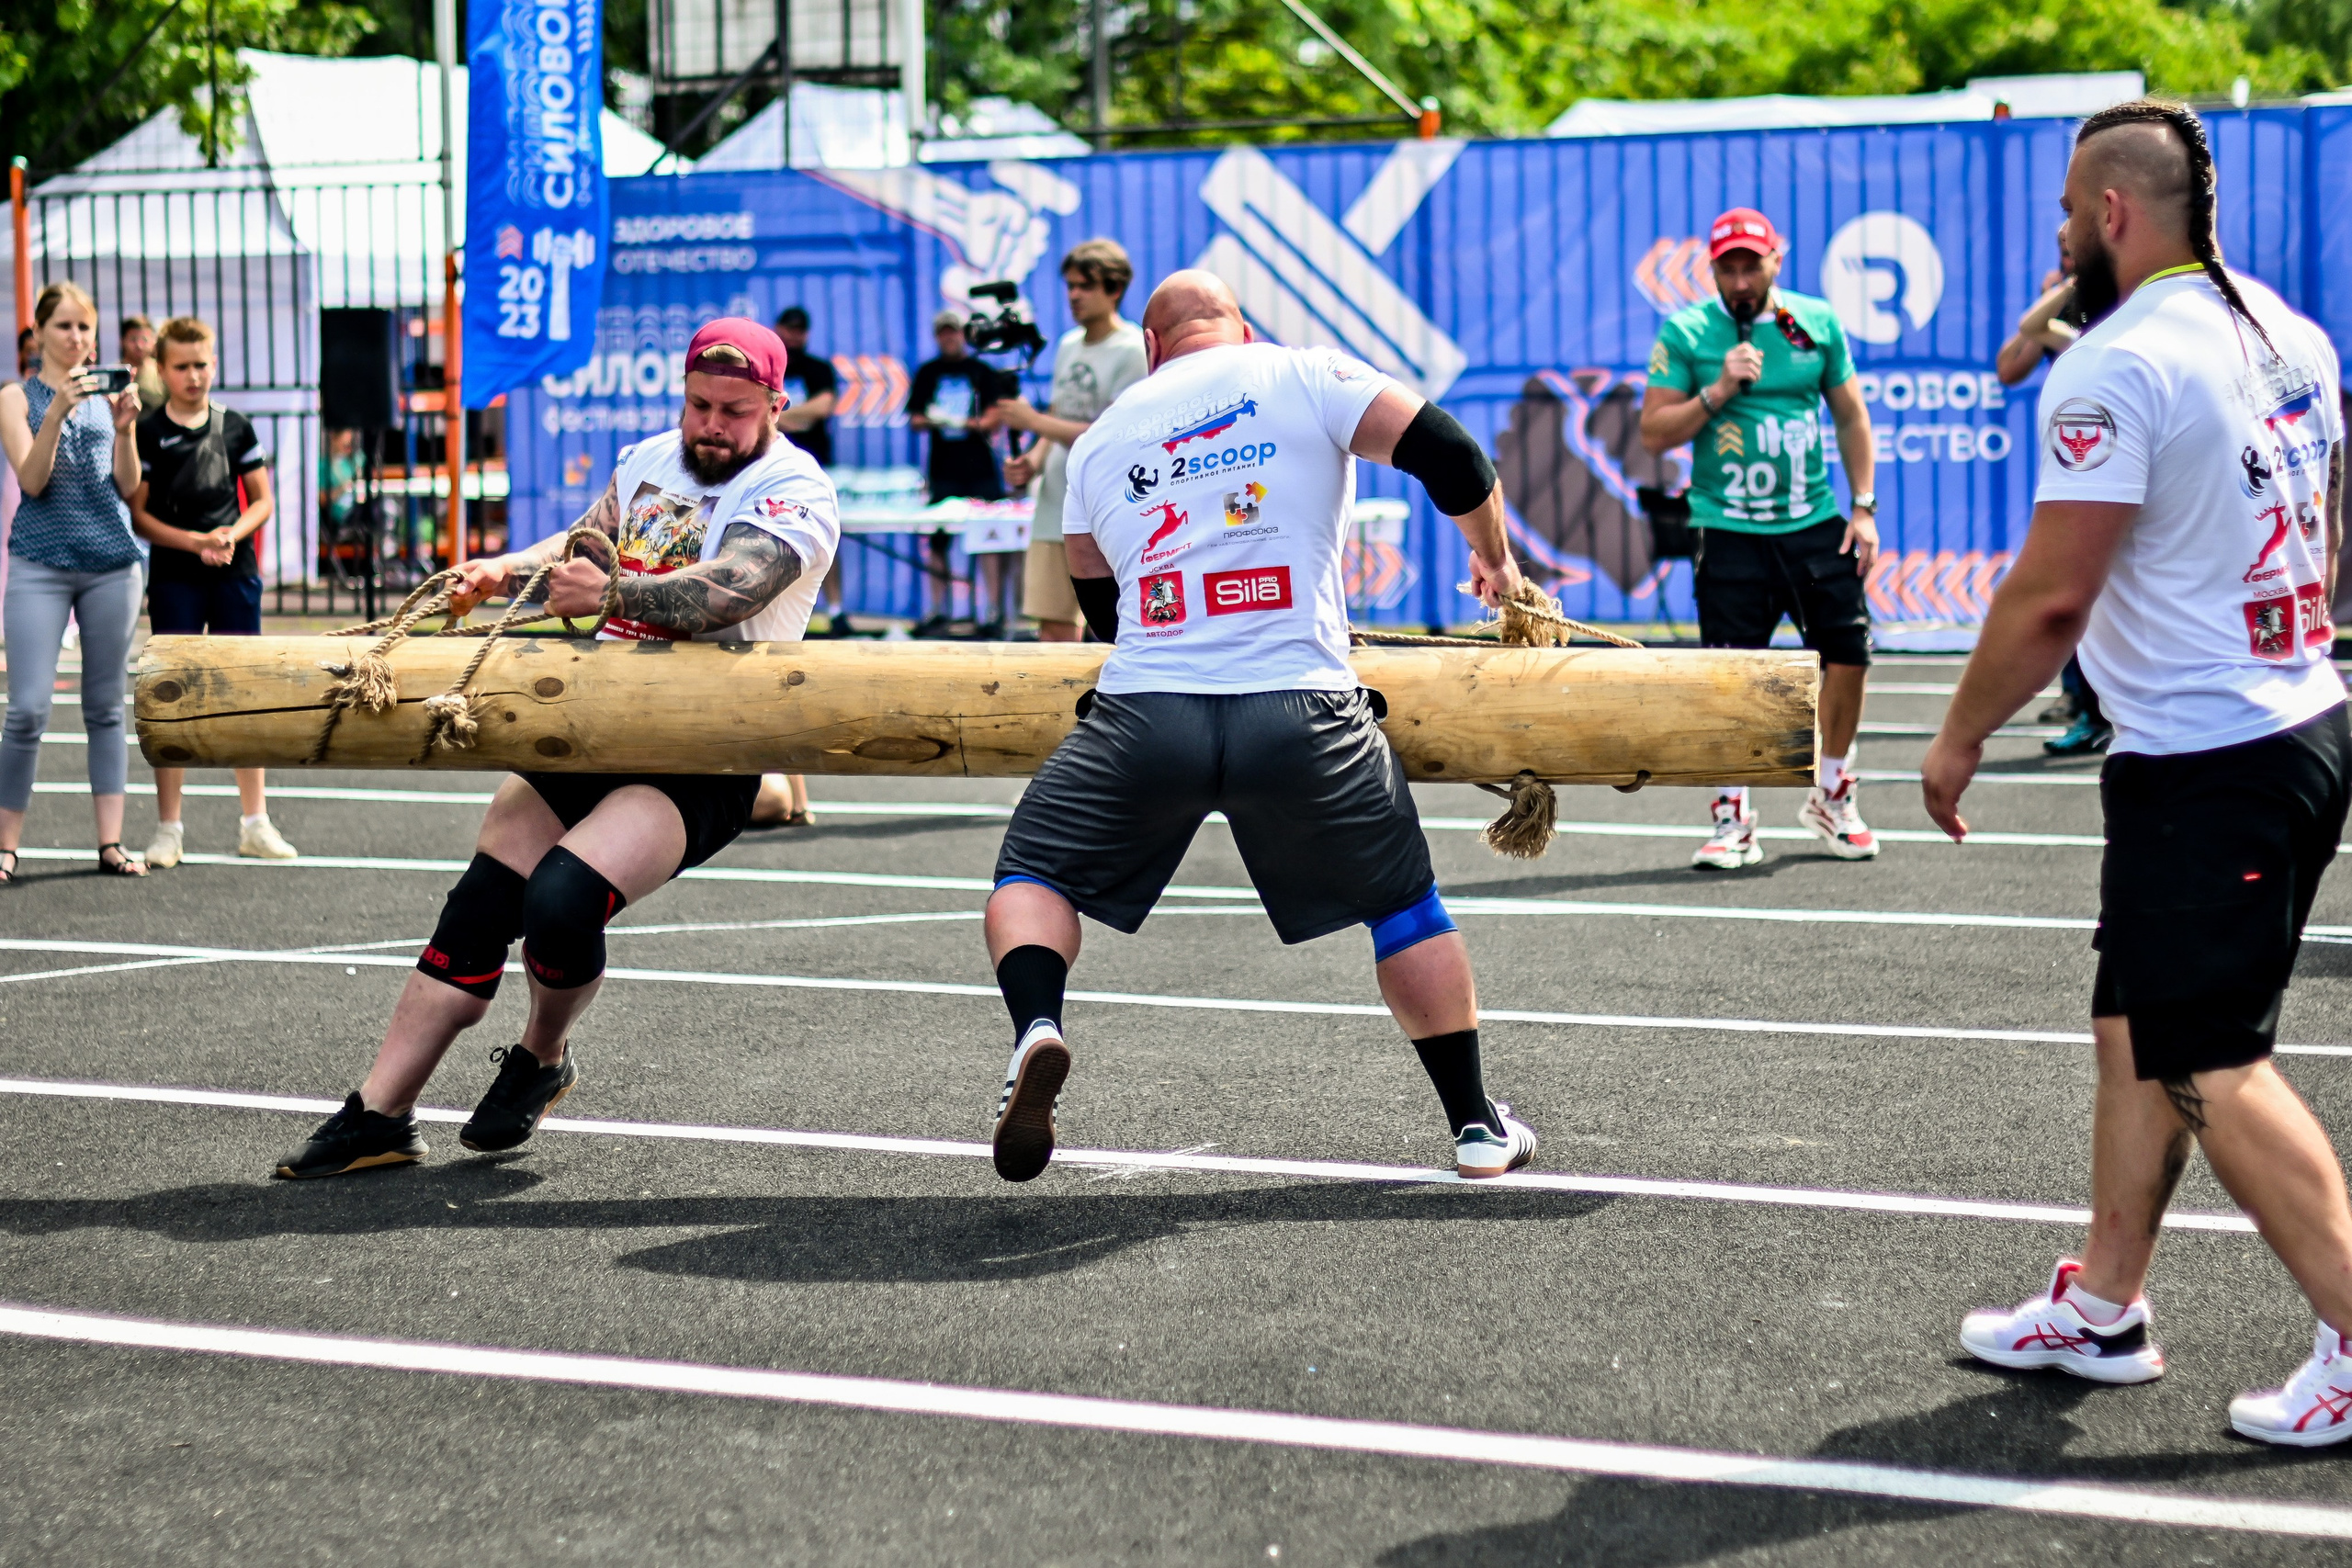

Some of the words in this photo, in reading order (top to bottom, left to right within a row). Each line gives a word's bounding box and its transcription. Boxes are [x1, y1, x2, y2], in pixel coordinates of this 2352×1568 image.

[535, 0, 576, 209] СИЛОВО
[613, 211, 755, 244] ЗДОРОВОЕ
[497, 264, 547, 302] 20
[497, 301, 541, 340] 23
[541, 351, 685, 399] СИЛОВ
[1857, 371, 2006, 410] РОВОЕ
[1114, 391, 1213, 443] ЗДОРОВОЕ
[1137, 390, 1244, 443] ОТЕЧЕСТВО
[1170, 442, 1277, 479] 2scoop
[2273, 439, 2327, 473] 2coop
[1170, 469, 1219, 486] СПОРТИВНОЕ
[1222, 462, 1256, 474] ПИТАНИЕ
[1721, 461, 1777, 497] 20
[1223, 526, 1279, 539] ПРОФСОЮЗ
[1147, 563, 1175, 574] ОСКВА
[2252, 562, 2290, 582] ФЕРМ
[1216, 578, 1281, 605] Sila
[2253, 586, 2290, 598] МОСКВА
[1146, 629, 1184, 638] АВТОДОР
[424, 947, 447, 966] BD
